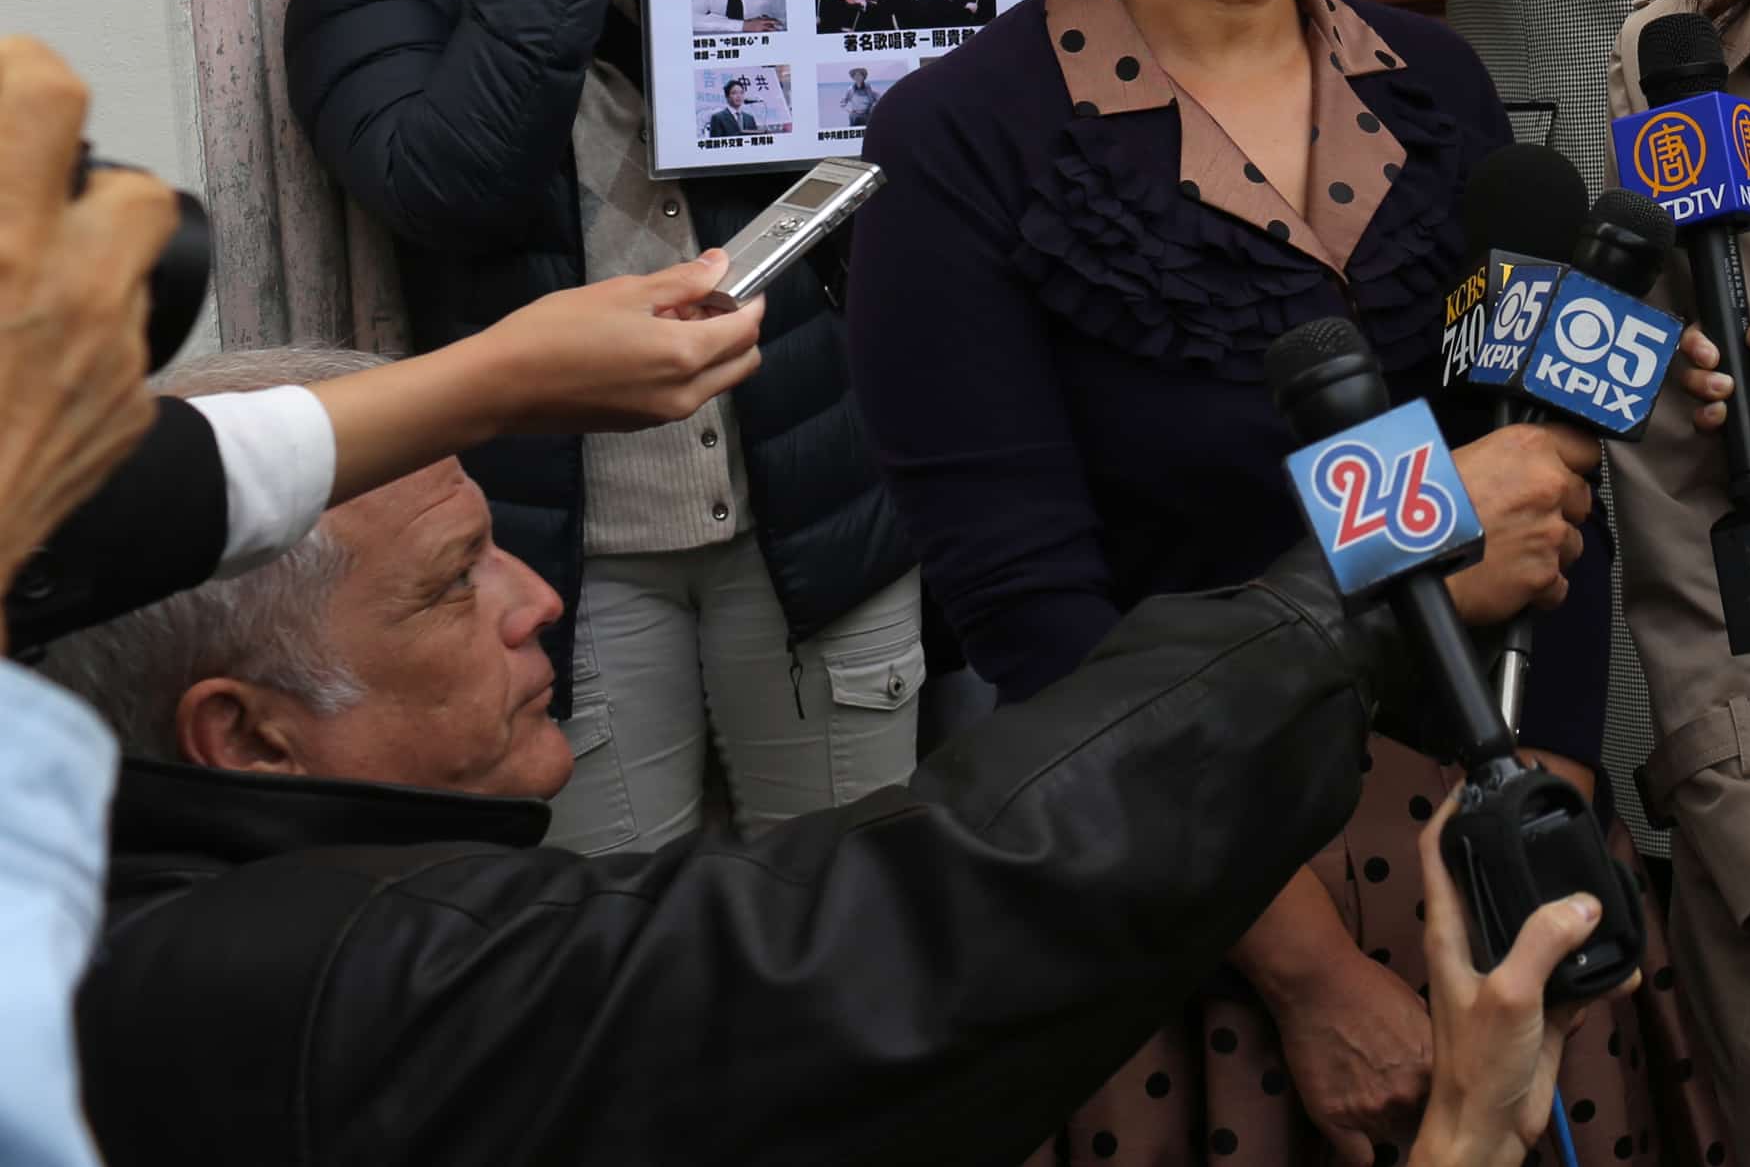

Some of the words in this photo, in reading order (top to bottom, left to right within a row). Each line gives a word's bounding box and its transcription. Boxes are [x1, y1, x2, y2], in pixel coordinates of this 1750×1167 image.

[1446, 265, 1487, 327] KCBS
[1441, 303, 1486, 387] 740
[1477, 343, 1526, 371] KPIX
[1535, 354, 1643, 422] KPIX
[1311, 440, 1458, 553] 26
